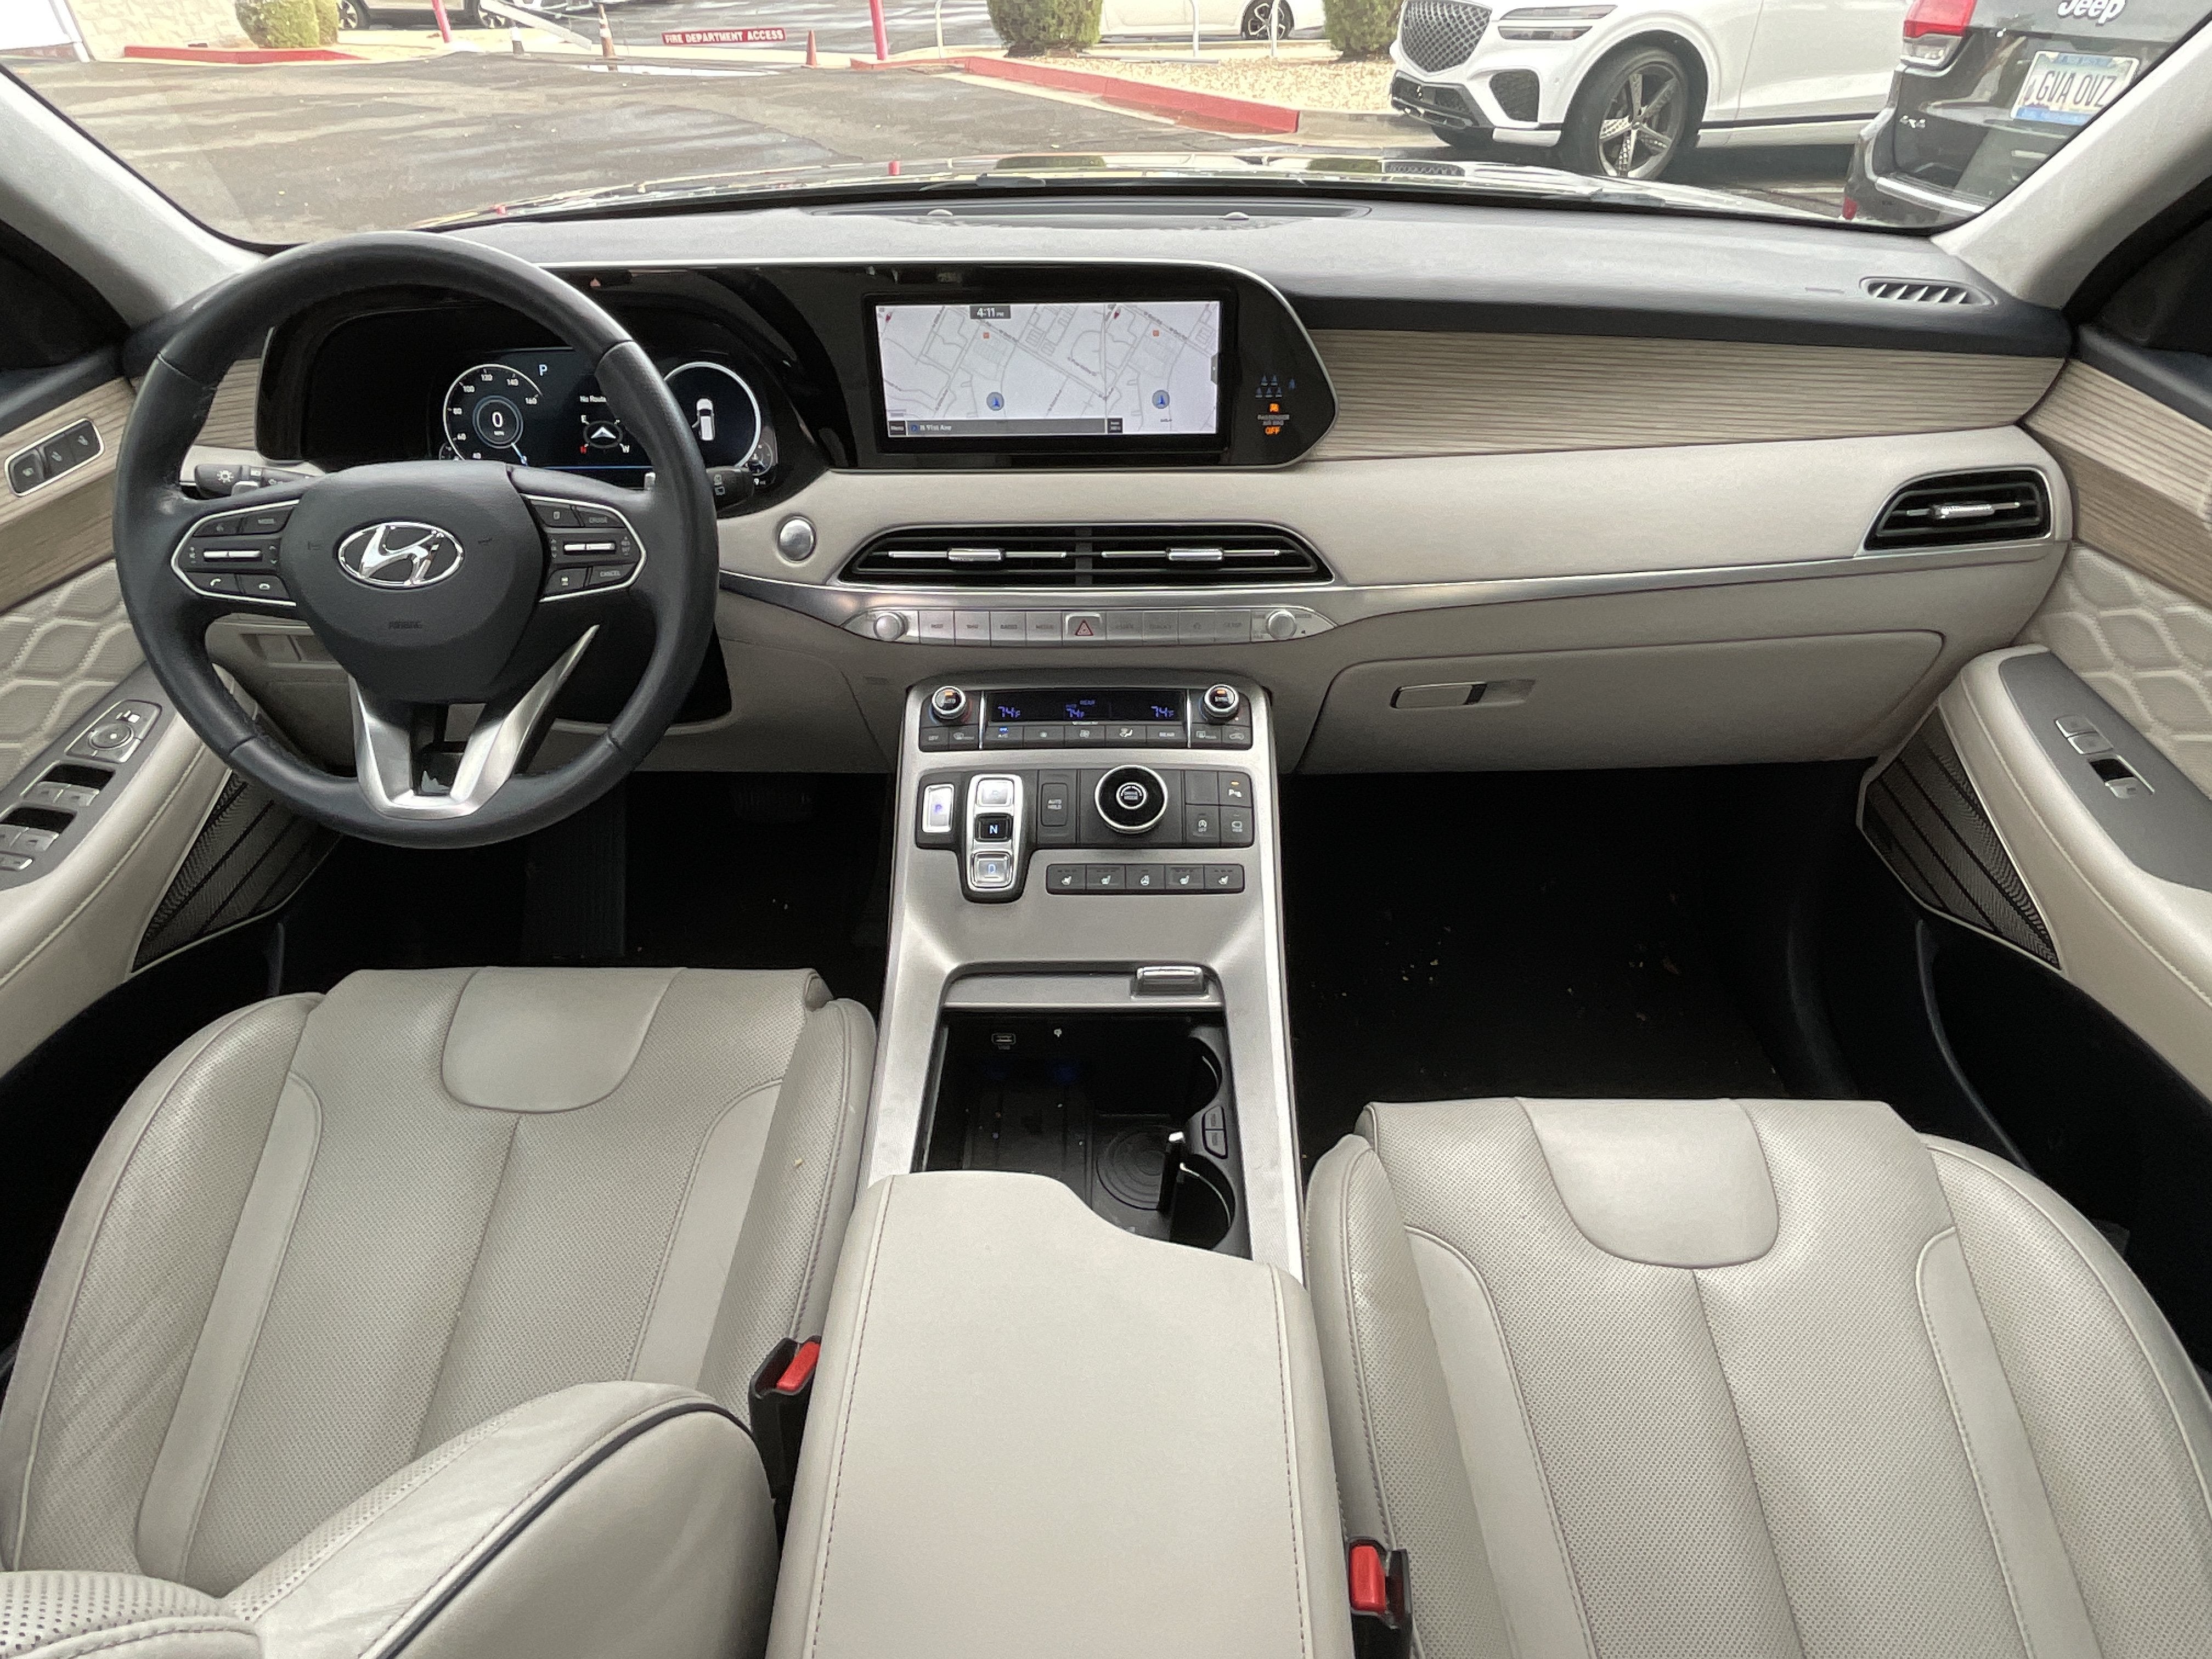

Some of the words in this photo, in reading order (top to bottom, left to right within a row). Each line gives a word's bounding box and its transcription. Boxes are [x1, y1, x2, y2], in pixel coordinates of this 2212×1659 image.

[2057, 0, 2126, 25] Jeep
[664, 35, 684, 44] FIRE
[685, 31, 743, 43] DEPARTMENT
[747, 30, 783, 41] ACCESS
[2036, 70, 2076, 103] GVA
[977, 307, 995, 318] 4:11
[539, 364, 548, 376] P
[492, 411, 503, 427] 0
[1265, 426, 1280, 435] OFF
[935, 804, 943, 812] P
[990, 824, 998, 834] N
[988, 864, 996, 873] D
